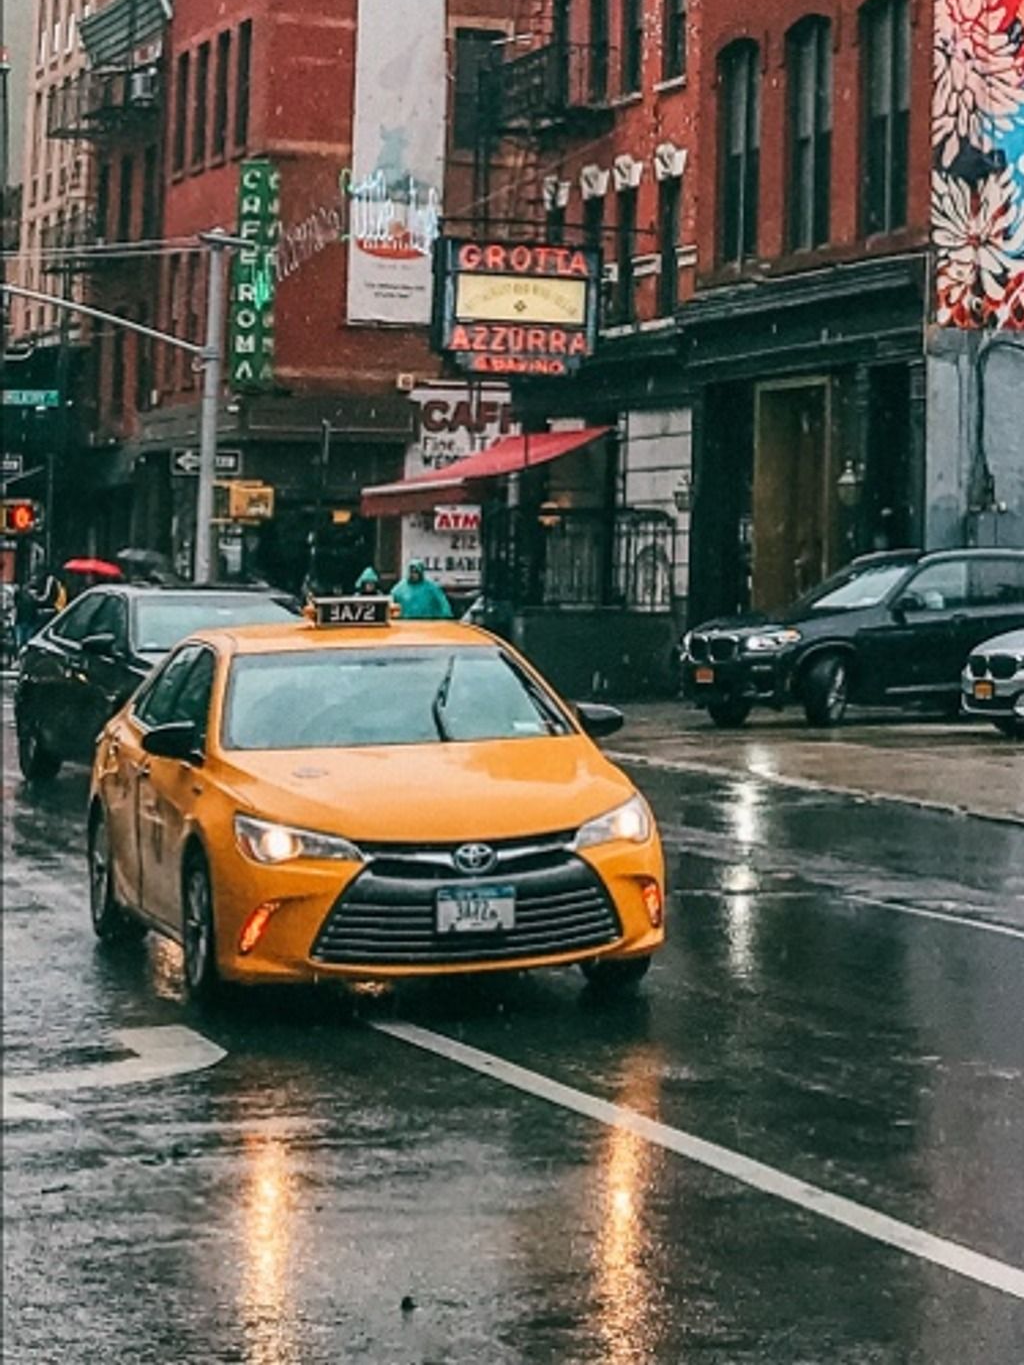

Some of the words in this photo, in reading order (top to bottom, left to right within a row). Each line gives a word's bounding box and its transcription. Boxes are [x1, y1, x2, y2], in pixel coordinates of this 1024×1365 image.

[459, 245, 589, 275] GROTTA
[234, 283, 258, 380] ROMA
[449, 325, 588, 356] AZZURRA
[437, 514, 479, 529] ATM
